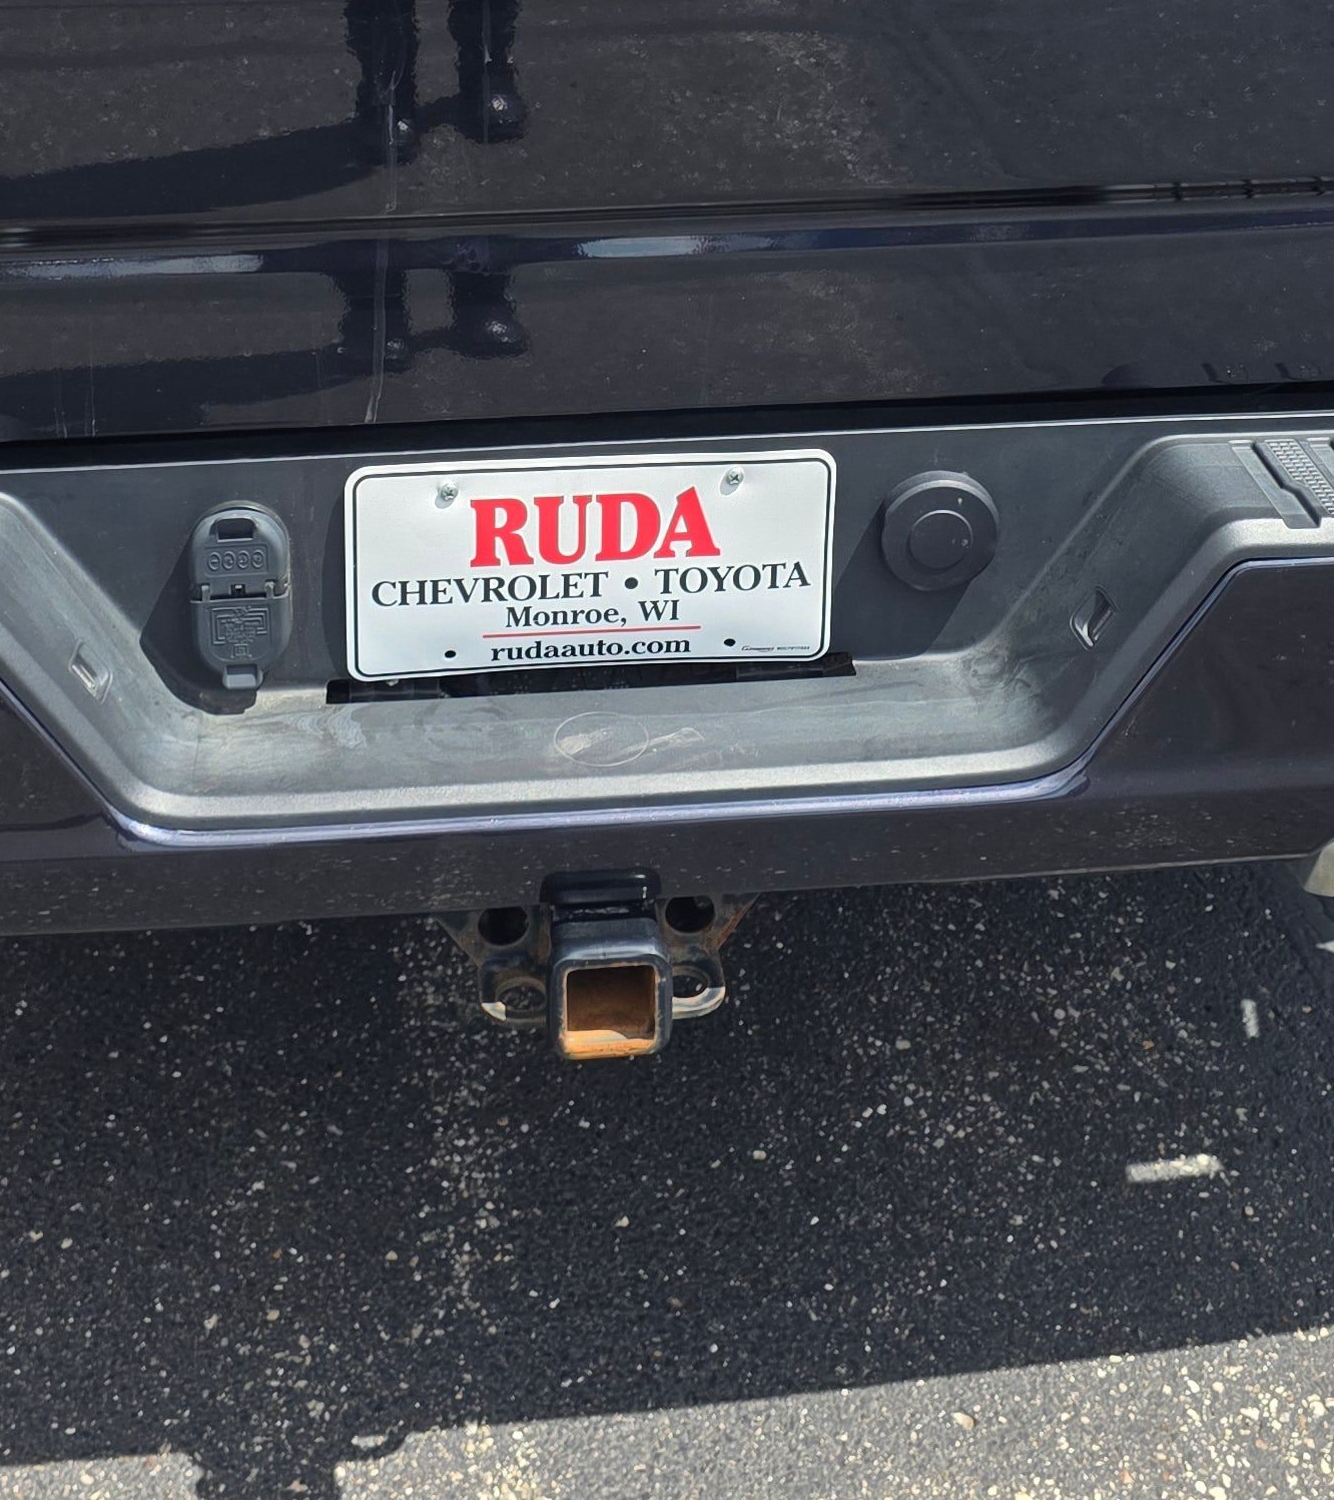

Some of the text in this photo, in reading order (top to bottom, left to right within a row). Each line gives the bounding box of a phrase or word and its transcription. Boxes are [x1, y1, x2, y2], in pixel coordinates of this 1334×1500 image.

[469, 485, 721, 568] RUDA
[371, 560, 812, 608] CHEVROLET TOYOTA
[504, 599, 681, 629] Monroe, WI
[489, 634, 692, 662] rudaauto.com
